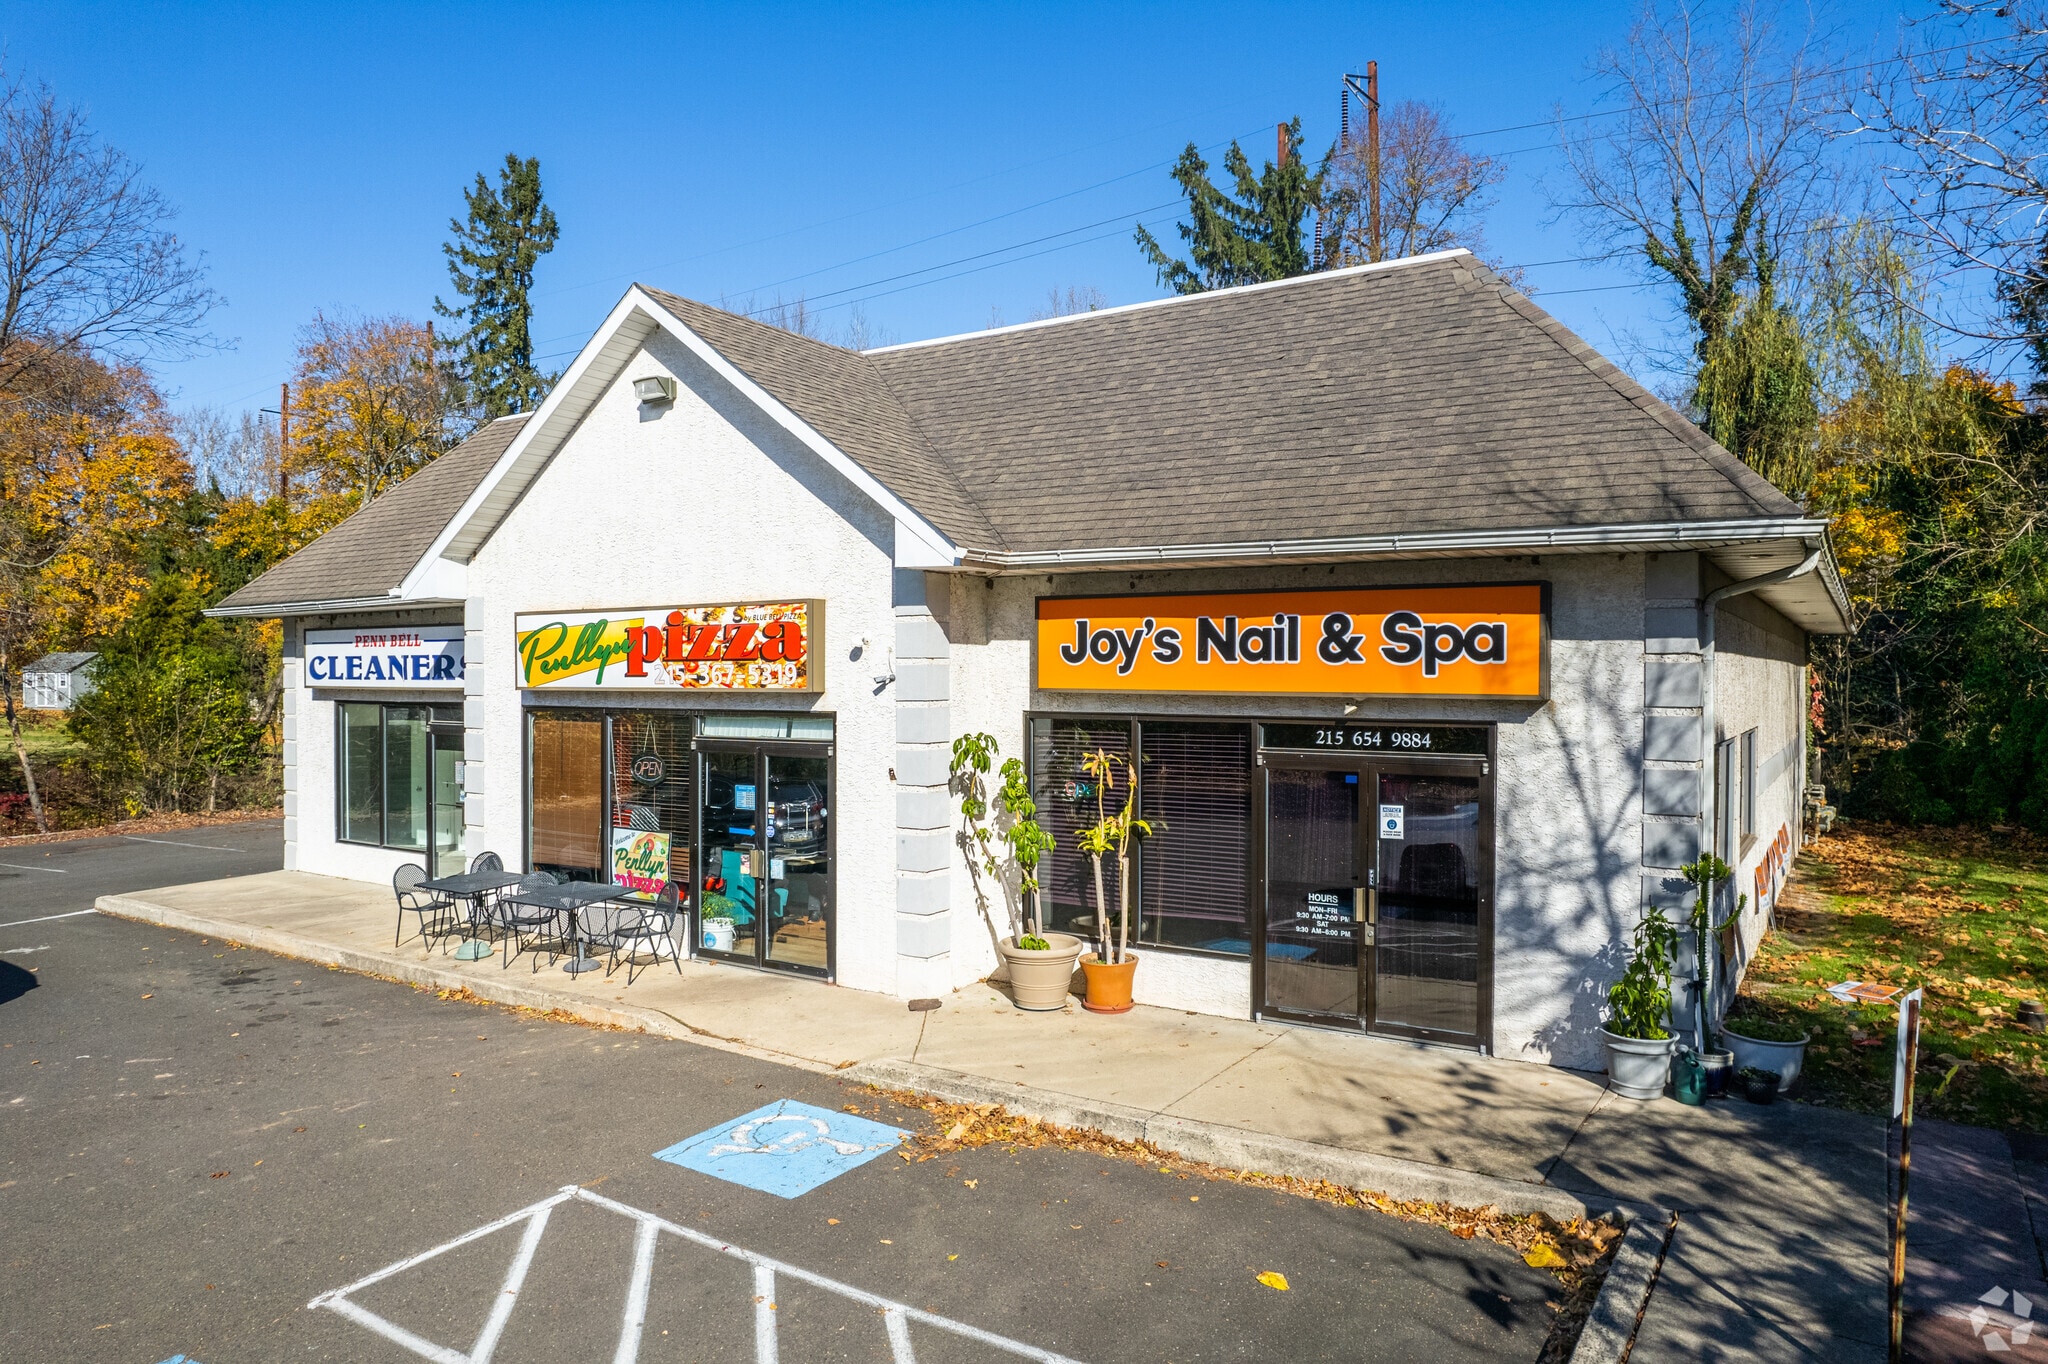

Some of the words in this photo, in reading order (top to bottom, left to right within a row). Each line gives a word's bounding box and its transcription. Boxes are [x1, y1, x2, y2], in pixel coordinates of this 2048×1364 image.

[752, 613, 767, 621] BLUE
[783, 612, 802, 620] PIZZA
[355, 635, 386, 648] PENN
[389, 633, 422, 647] BELL
[518, 619, 637, 686] Penllyn
[624, 611, 803, 677] pizza
[1060, 617, 1183, 676] Joy's
[1196, 613, 1301, 664] Nail
[1317, 611, 1366, 666] &
[1379, 610, 1507, 678] Spa
[309, 654, 465, 681] CLEANER
[654, 663, 798, 685] 215-367-5319
[1315, 730, 1344, 745] 215
[1352, 731, 1382, 746] 654
[1391, 732, 1431, 748] 9884
[634, 761, 663, 776] OPEN
[615, 847, 665, 879] Penllyn
[1308, 893, 1338, 903] HOURS
